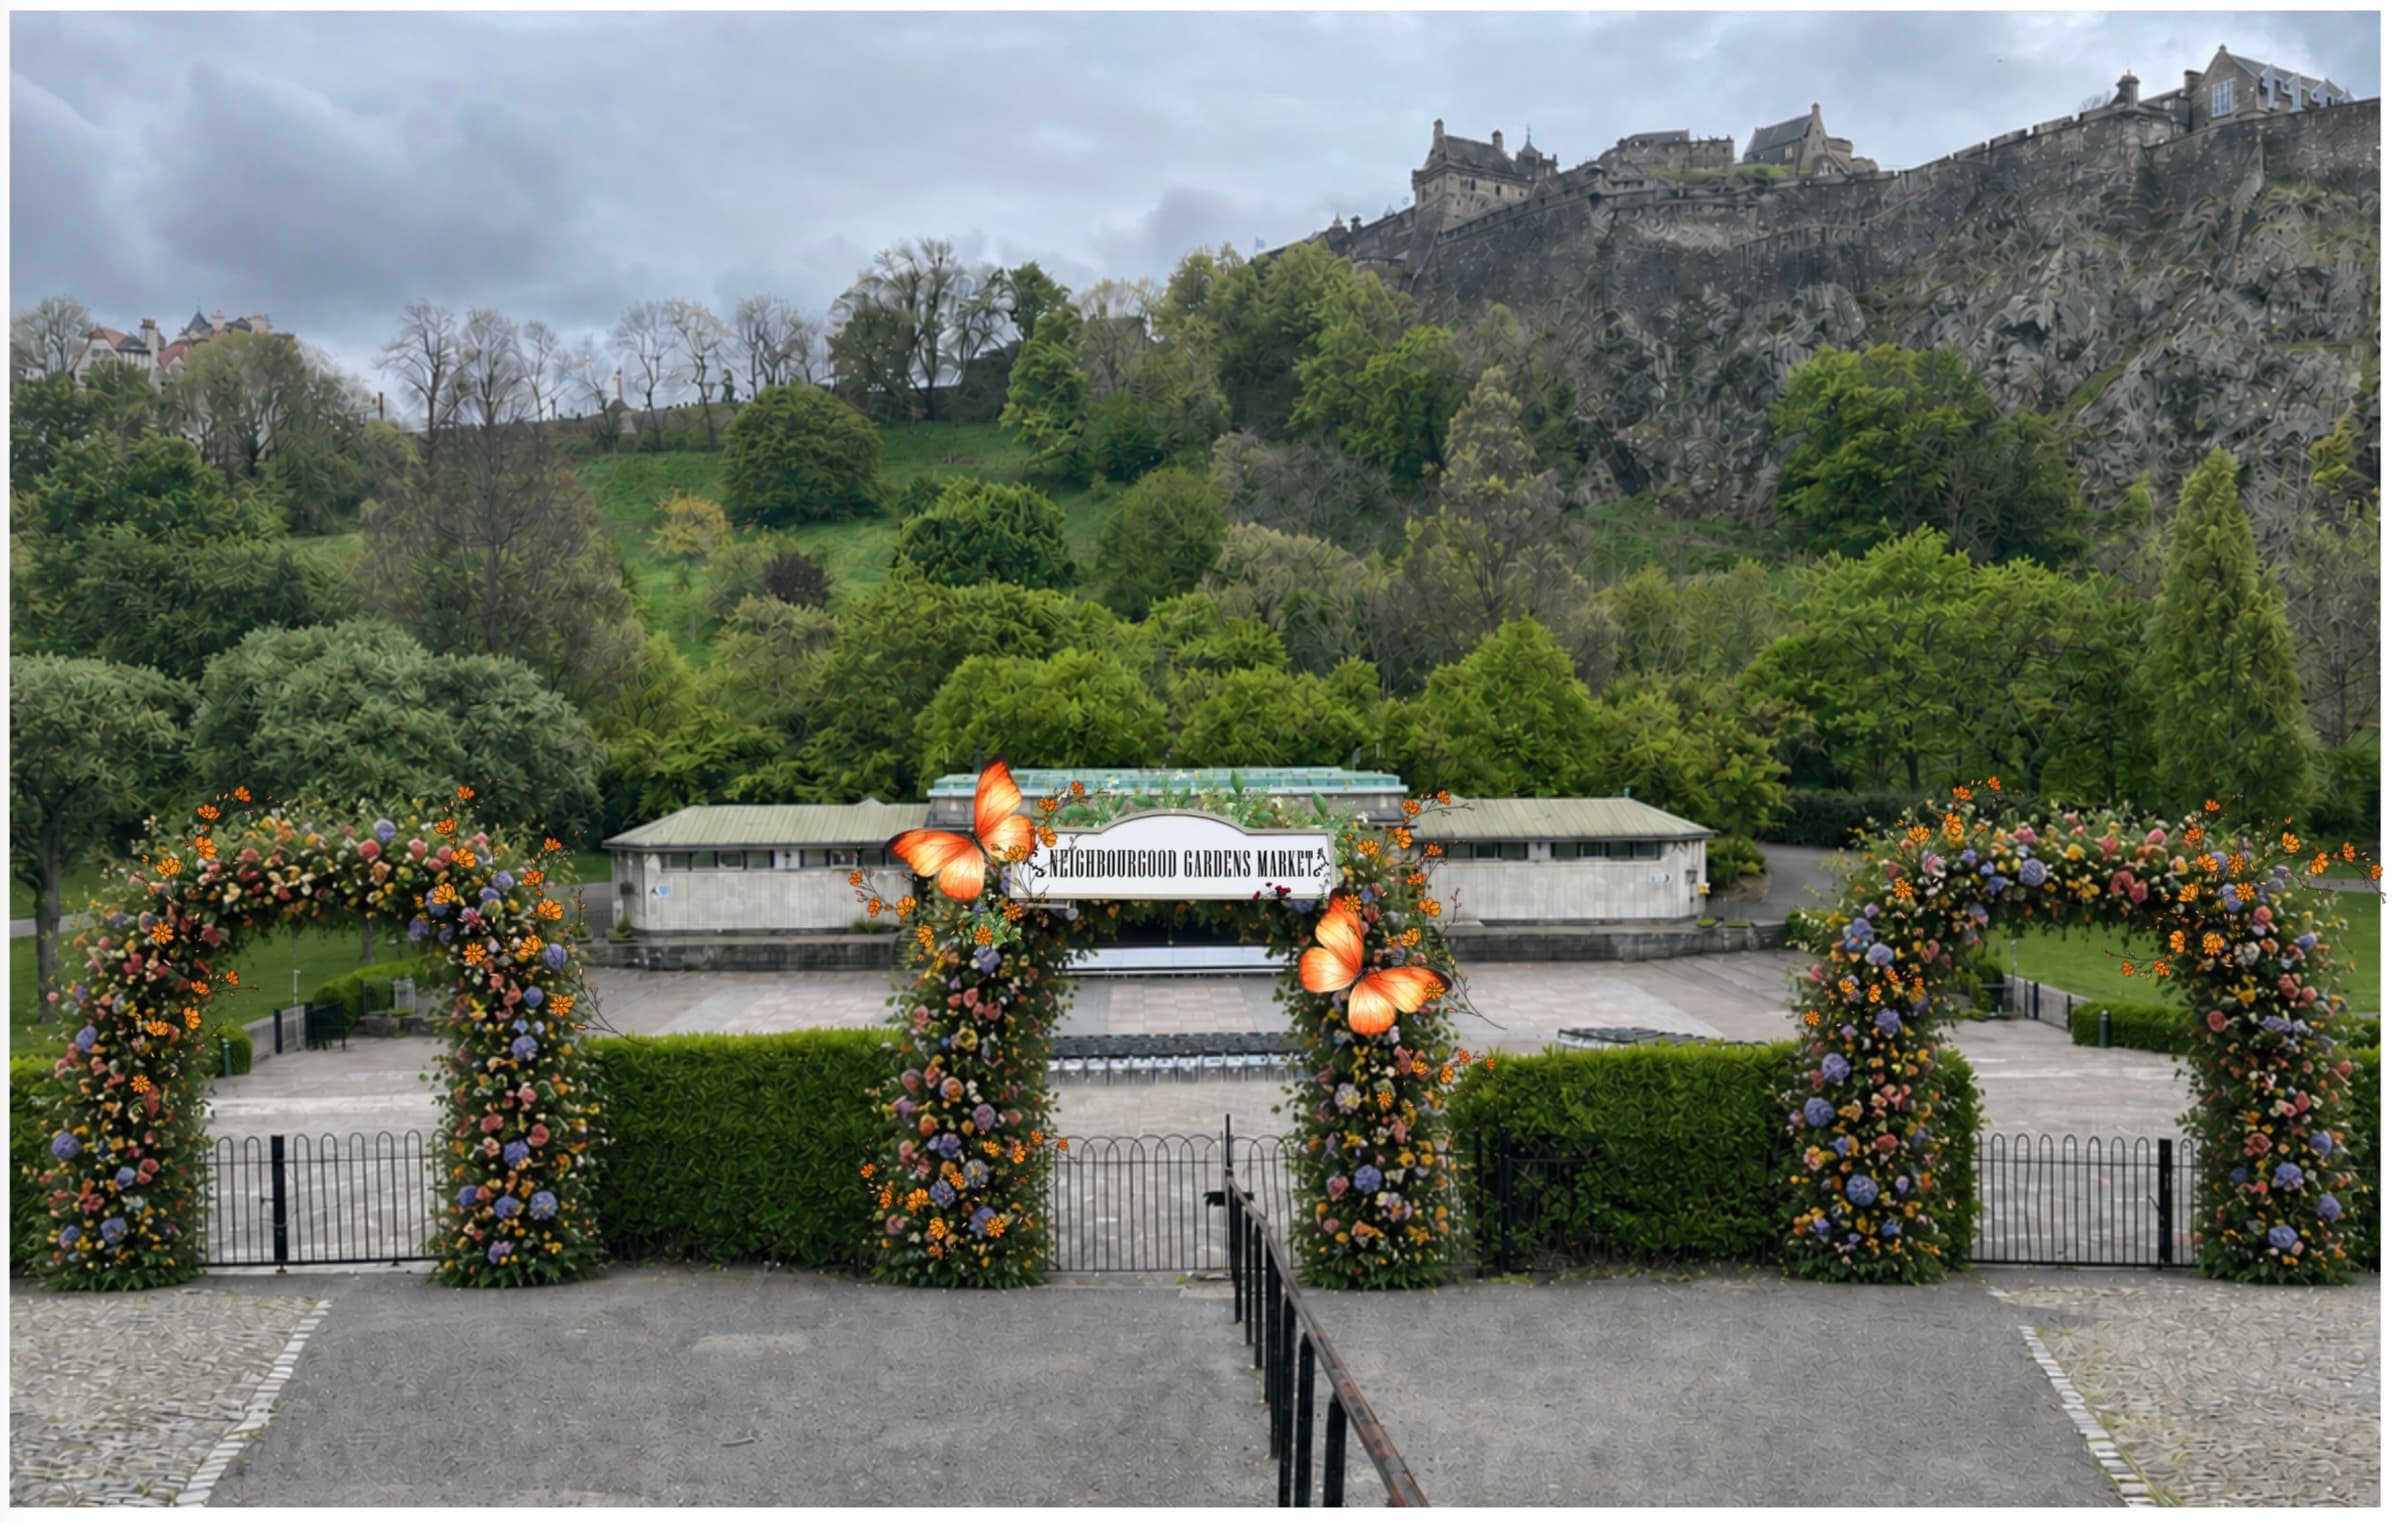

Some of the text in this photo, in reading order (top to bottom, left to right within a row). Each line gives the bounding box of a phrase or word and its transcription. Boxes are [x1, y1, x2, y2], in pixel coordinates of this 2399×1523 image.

[1049, 849, 1314, 878] NEIGHBOURGOOD GARDENS MARKET
